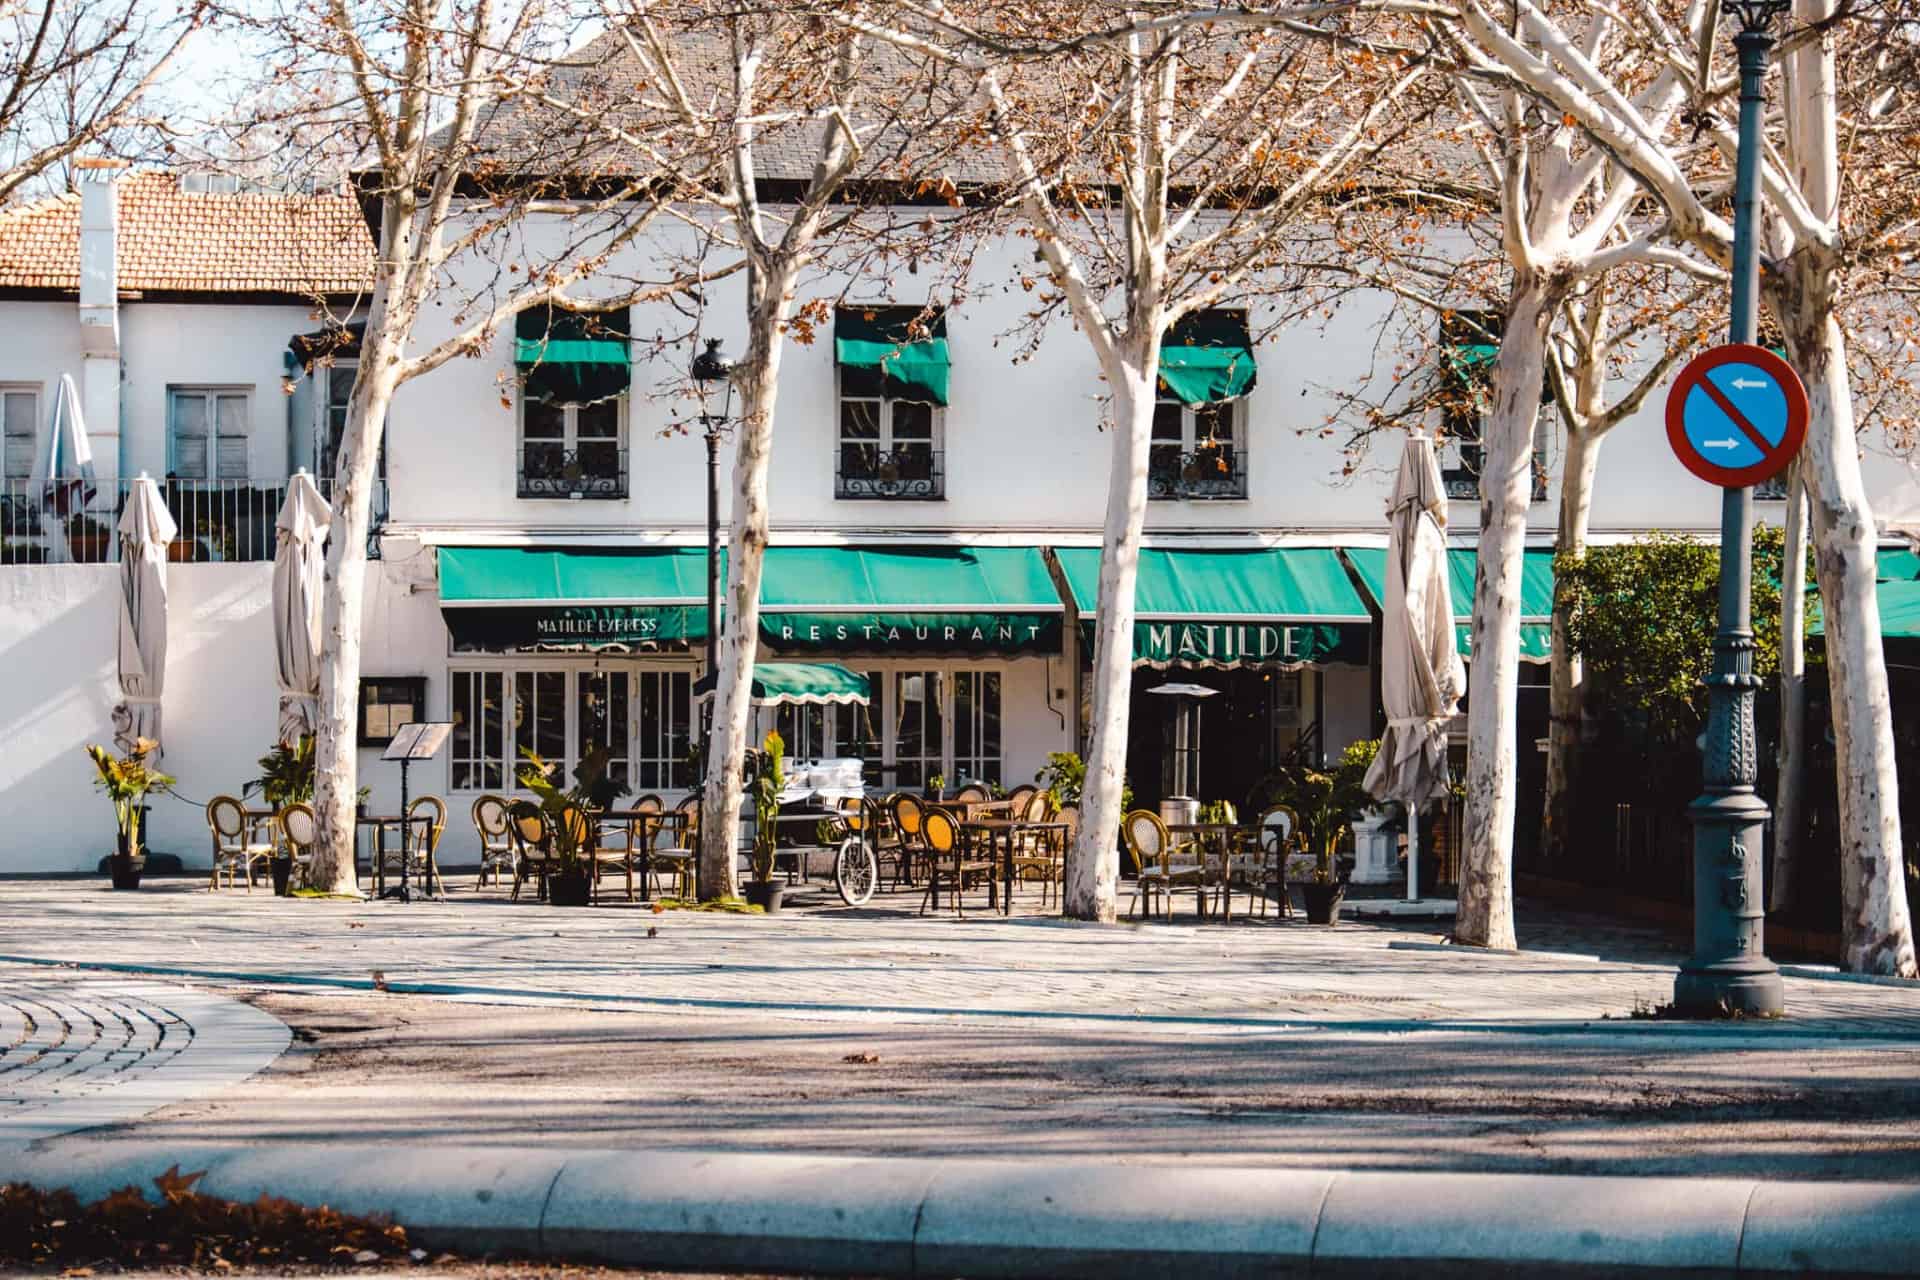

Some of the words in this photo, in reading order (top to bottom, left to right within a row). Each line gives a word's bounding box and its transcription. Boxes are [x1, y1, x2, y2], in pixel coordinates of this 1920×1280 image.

[537, 616, 593, 633] MATILDE
[599, 617, 657, 633] EXPRESS
[782, 625, 1041, 641] RESTAURANT
[1149, 624, 1302, 658] MATILDE
